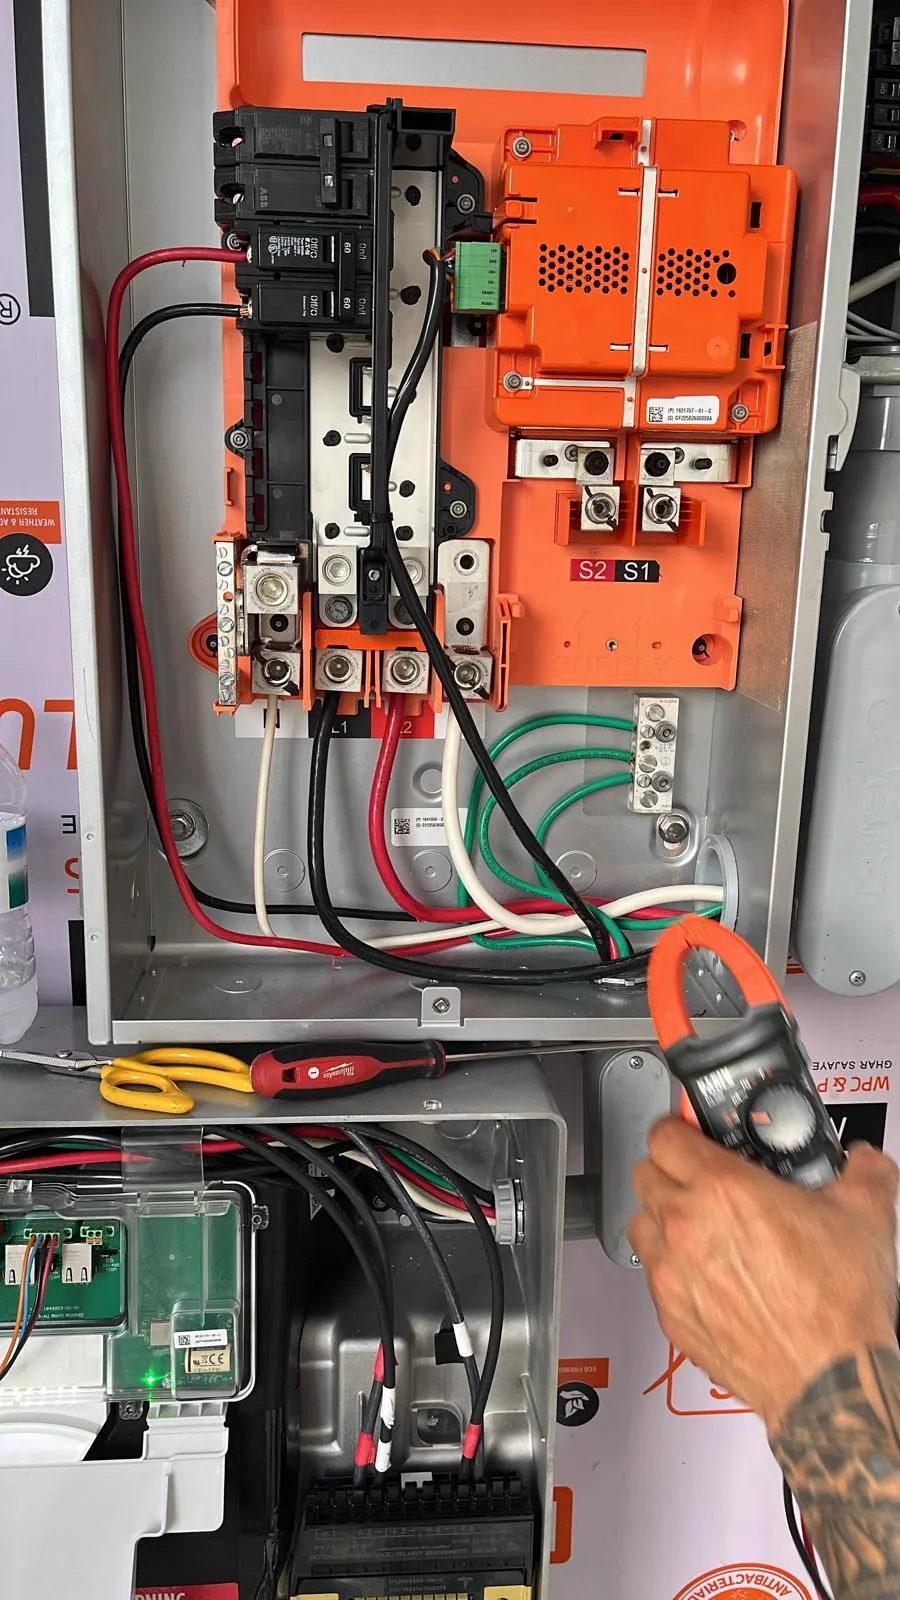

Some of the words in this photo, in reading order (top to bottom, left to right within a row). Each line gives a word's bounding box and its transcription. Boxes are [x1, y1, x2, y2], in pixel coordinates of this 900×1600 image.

[259, 187, 269, 208] ABB
[343, 242, 352, 254] 60
[343, 297, 351, 309] 60
[10, 518, 17, 527] &
[19, 518, 56, 527] WEATHER
[578, 560, 607, 580] S2
[623, 561, 650, 581] S1
[812, 1061, 856, 1071] SAJAYE
[860, 1060, 893, 1070] GHAR
[833, 1076, 847, 1093] &
[850, 1075, 890, 1092] WPC
